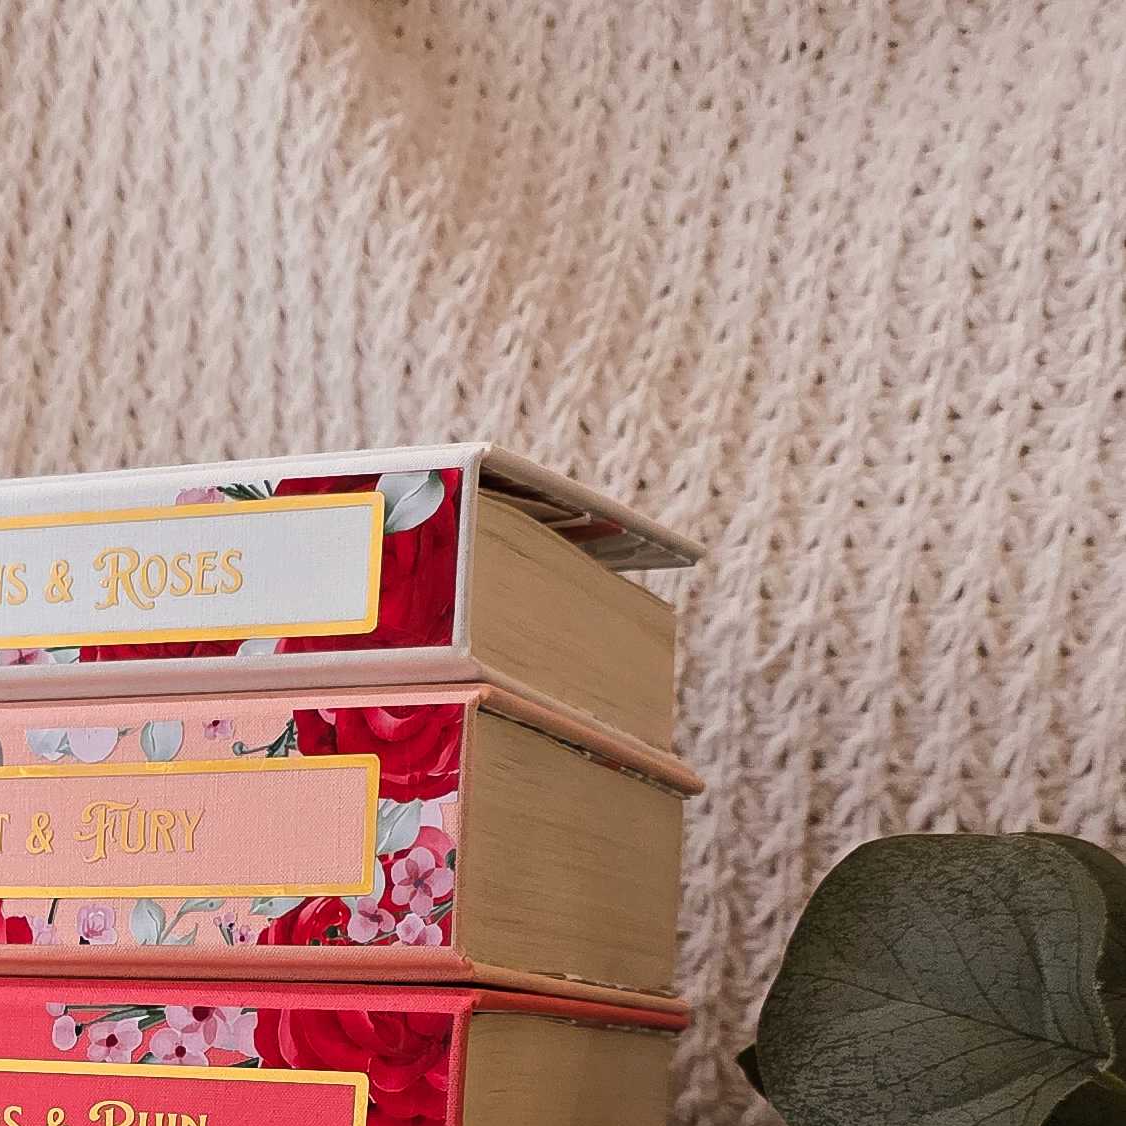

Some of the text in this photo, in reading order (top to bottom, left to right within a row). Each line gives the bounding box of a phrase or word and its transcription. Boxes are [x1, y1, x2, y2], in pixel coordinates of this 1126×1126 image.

[45, 562, 72, 603] &
[93, 547, 244, 610] ROSES
[27, 817, 55, 854] &
[74, 799, 204, 863] FURY
